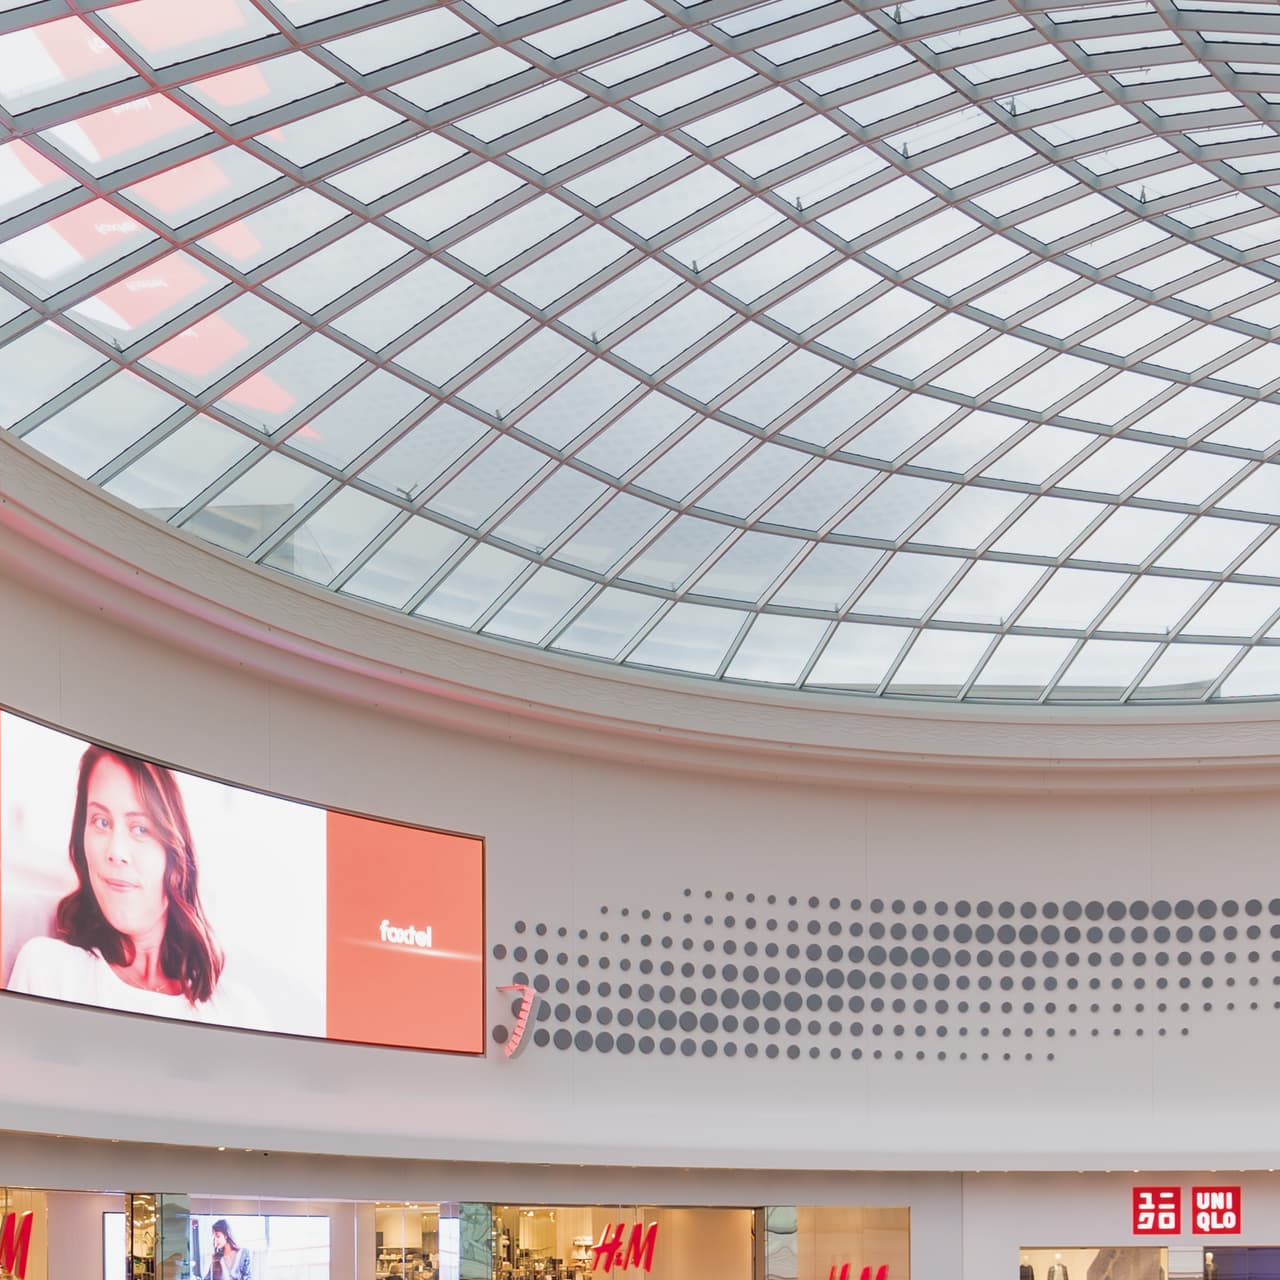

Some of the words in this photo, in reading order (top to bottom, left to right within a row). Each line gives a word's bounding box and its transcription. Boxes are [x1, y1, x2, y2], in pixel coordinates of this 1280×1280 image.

[379, 919, 432, 947] foxtel
[1196, 1192, 1233, 1210] UNI
[1197, 1211, 1237, 1232] QLO
[591, 1221, 659, 1273] H&M
